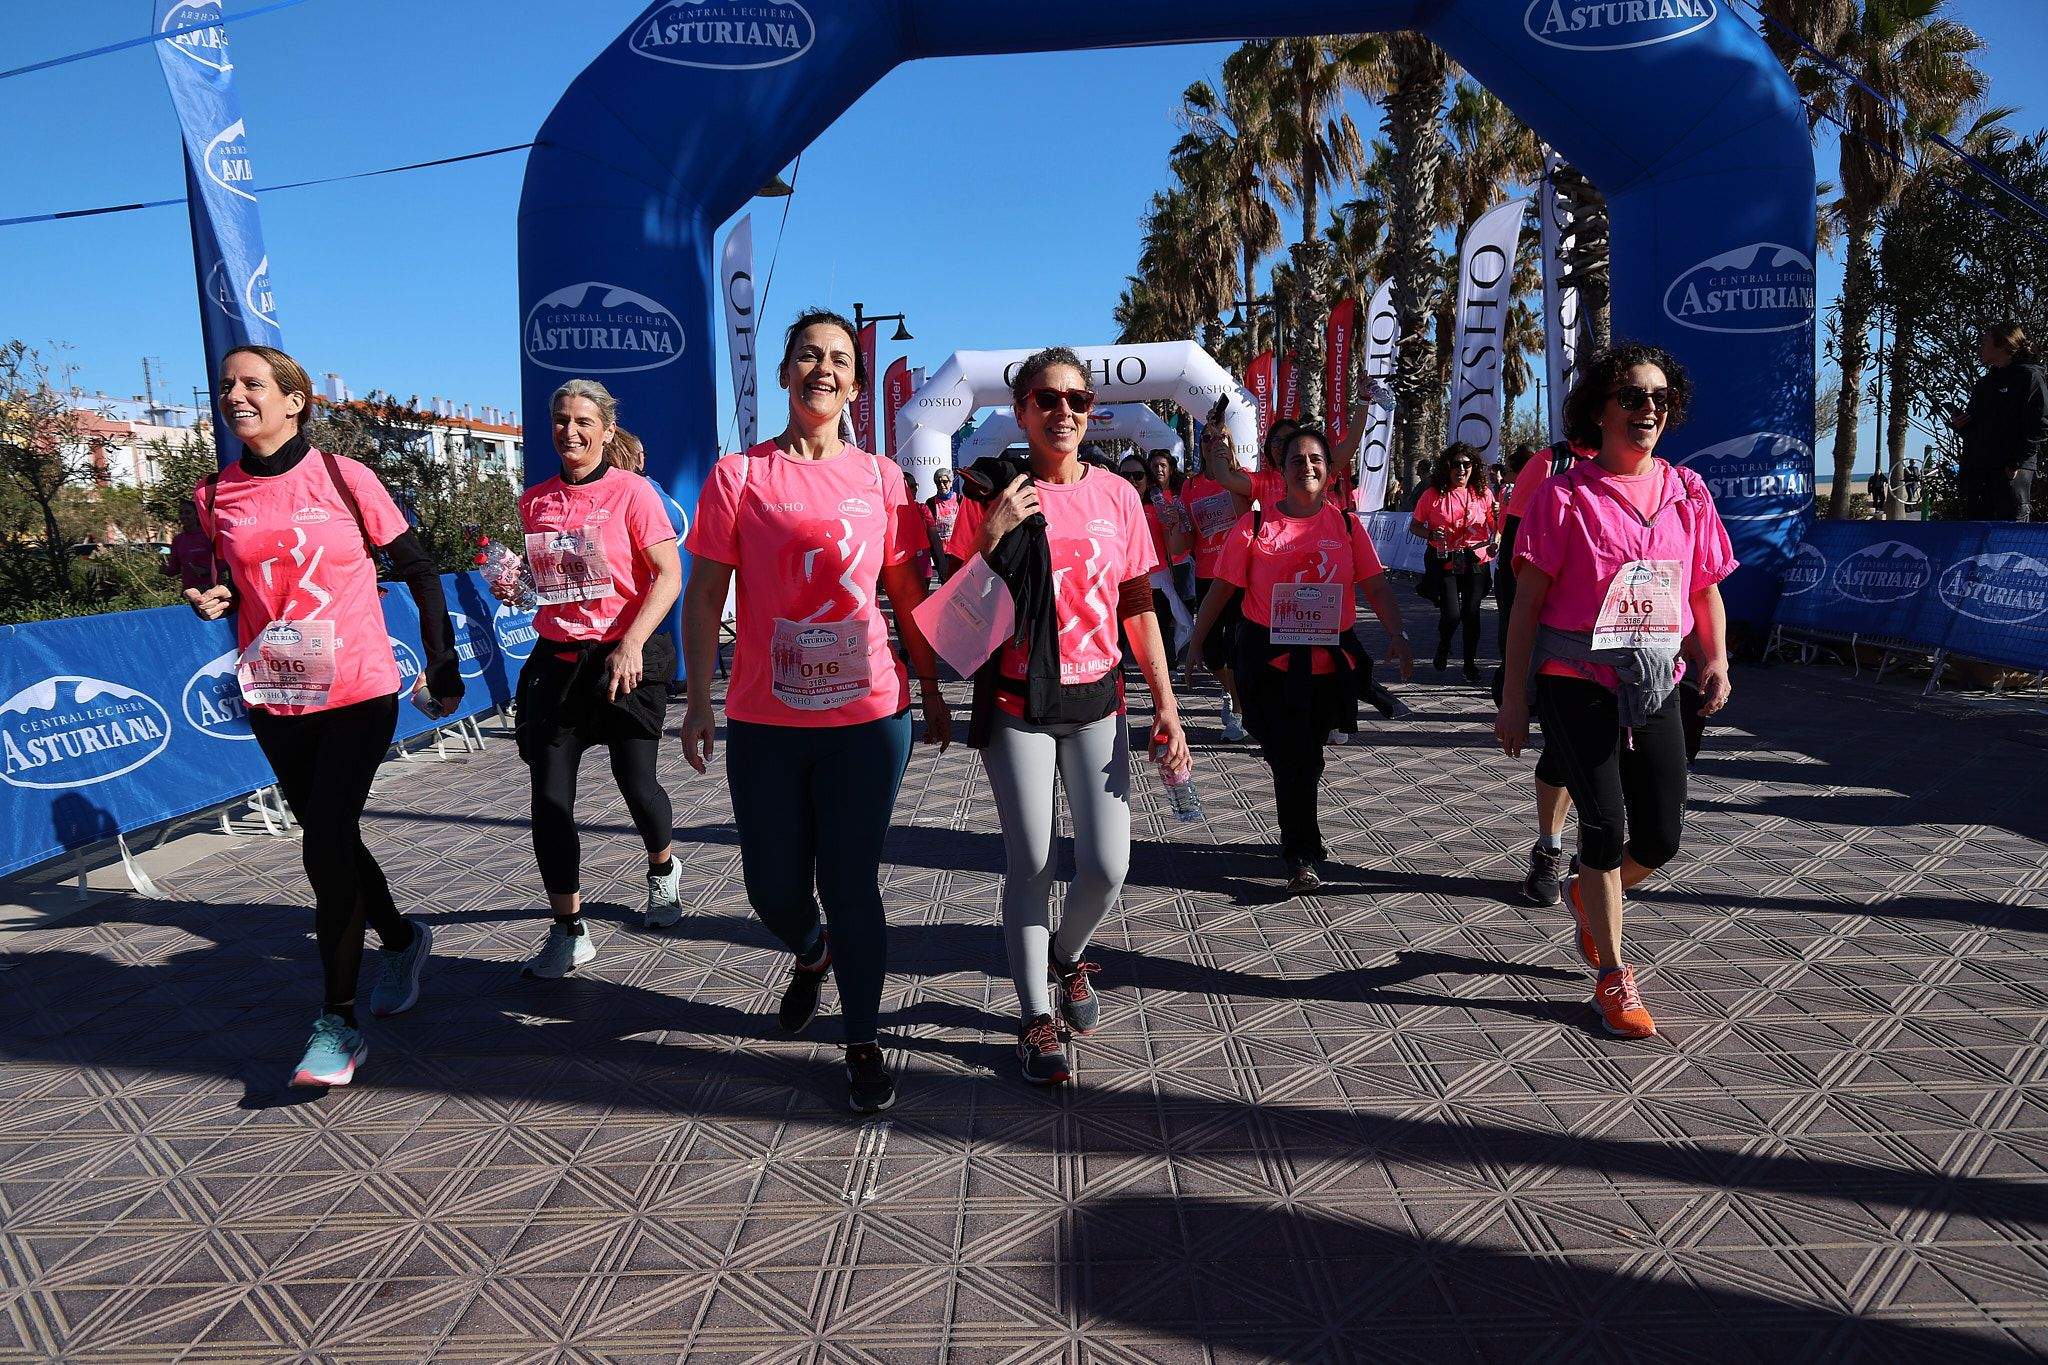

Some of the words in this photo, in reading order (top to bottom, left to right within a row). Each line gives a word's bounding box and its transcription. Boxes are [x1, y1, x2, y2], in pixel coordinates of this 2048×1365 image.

[669, 8, 729, 20] CENTRAL
[732, 7, 795, 19] LECHERA
[1539, 0, 1708, 35] ASTURIANA
[639, 19, 801, 49] ASTURIANA
[1709, 275, 1771, 287] CENTRAL
[547, 314, 602, 324] CENTRAL
[608, 314, 669, 328] LECHERA
[530, 319, 675, 355] ASTURIANA
[1457, 245, 1506, 450] OYSHO
[1333, 324, 1345, 413] Santander
[1188, 384, 1232, 396] OYSHO
[1363, 311, 1396, 472] OYHO
[919, 397, 962, 408] OYSHO
[1255, 373, 1267, 437] Santander
[902, 456, 942, 466] OYSHO
[1709, 463, 1771, 474] CENTRAL
[762, 502, 805, 513] OYSHO
[556, 561, 585, 575] 016
[1838, 561, 1921, 588] ASTURIANA
[1619, 600, 1654, 614] 016
[1295, 610, 1322, 621] 016
[270, 660, 306, 673] 016
[800, 661, 840, 677] 016
[1061, 662, 1073, 675] DE
[1075, 661, 1087, 673] LA
[808, 678, 828, 688] 3189
[781, 694, 811, 706] OYSHO
[20, 712, 85, 734] CENTRAL
[86, 701, 146, 720] LECHERA
[2, 715, 165, 775] ASTURIANA
